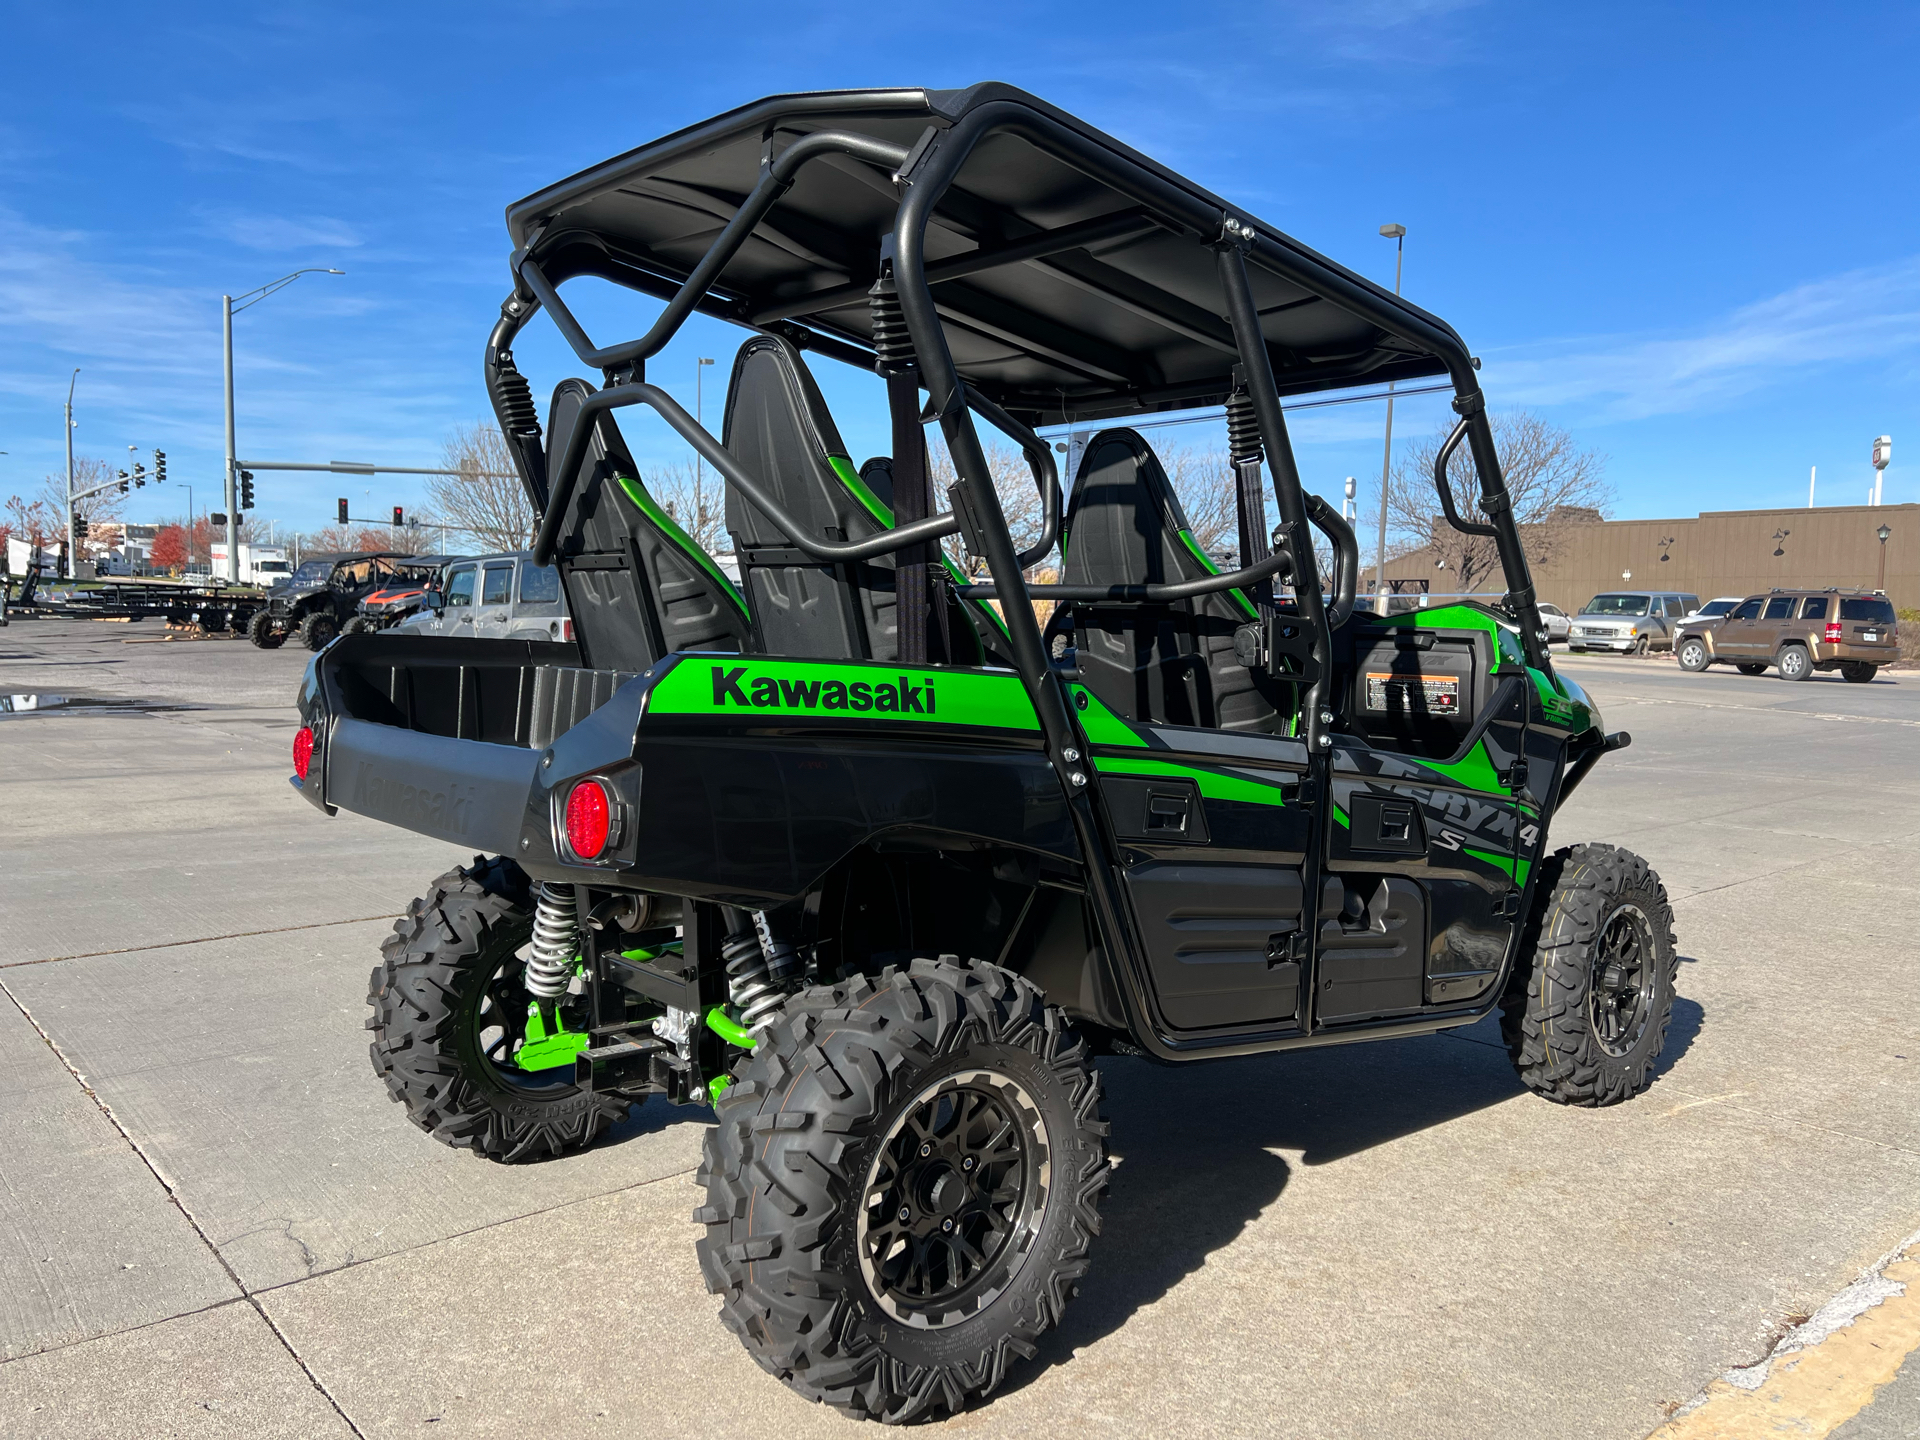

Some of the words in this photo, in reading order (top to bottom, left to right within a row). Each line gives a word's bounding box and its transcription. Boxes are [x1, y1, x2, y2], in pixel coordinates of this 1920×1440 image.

[711, 665, 937, 715] Kawasaki
[1545, 698, 1572, 716] SE
[353, 761, 476, 835] Kawasaki
[1430, 827, 1466, 852] S
[751, 910, 776, 957] FOX
[1029, 1063, 1052, 1086] RADIAL
[507, 1103, 540, 1119] 2.0
[545, 1093, 601, 1118] HORN
[1040, 1135, 1079, 1269] BIGHORN
[1008, 1270, 1042, 1315] 2.0
